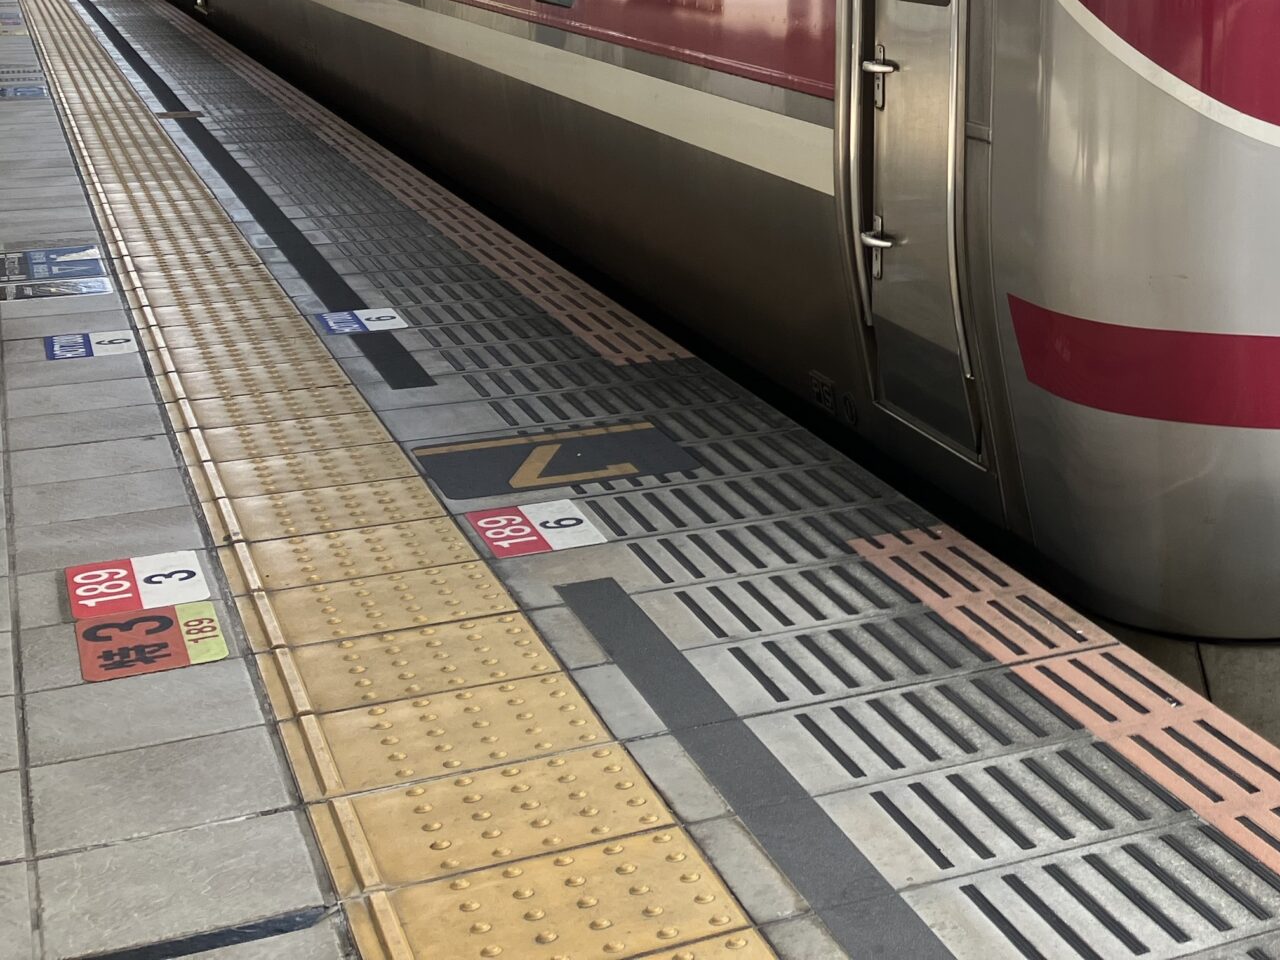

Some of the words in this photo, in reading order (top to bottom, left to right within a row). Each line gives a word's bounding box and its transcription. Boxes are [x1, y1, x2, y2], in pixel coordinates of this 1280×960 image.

[477, 515, 538, 548] 189
[539, 517, 584, 530] 6
[73, 568, 133, 608] 189
[143, 569, 197, 585] 3
[183, 617, 219, 644] 189
